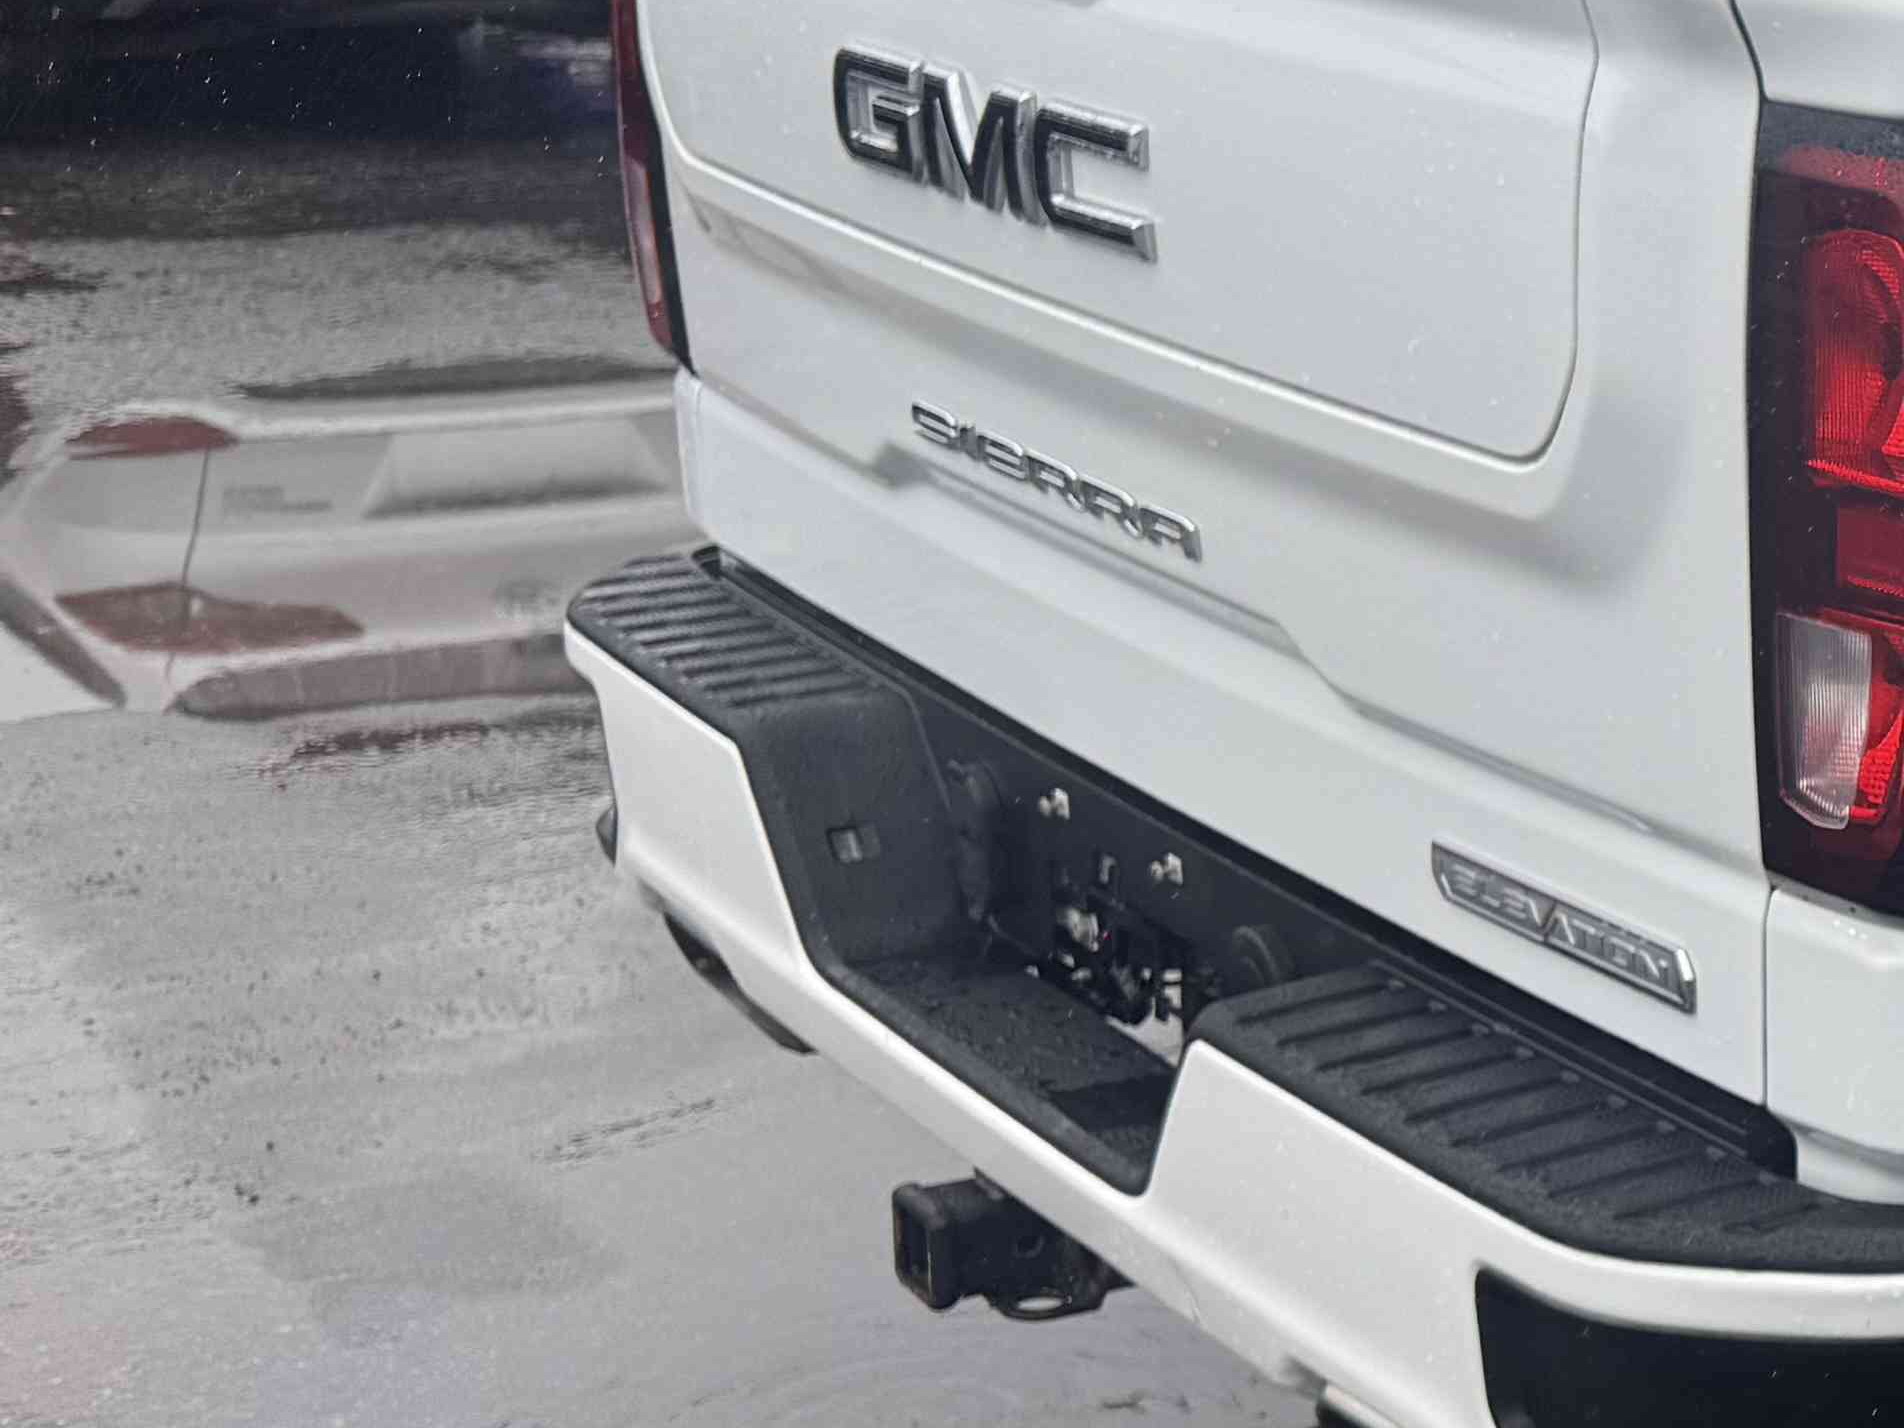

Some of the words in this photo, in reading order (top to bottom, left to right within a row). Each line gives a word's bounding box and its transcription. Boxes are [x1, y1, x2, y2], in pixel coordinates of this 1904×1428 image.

[832, 44, 1159, 265] GMC
[910, 398, 1203, 564] SIERRA
[1451, 862, 1676, 983] ELEVATION
